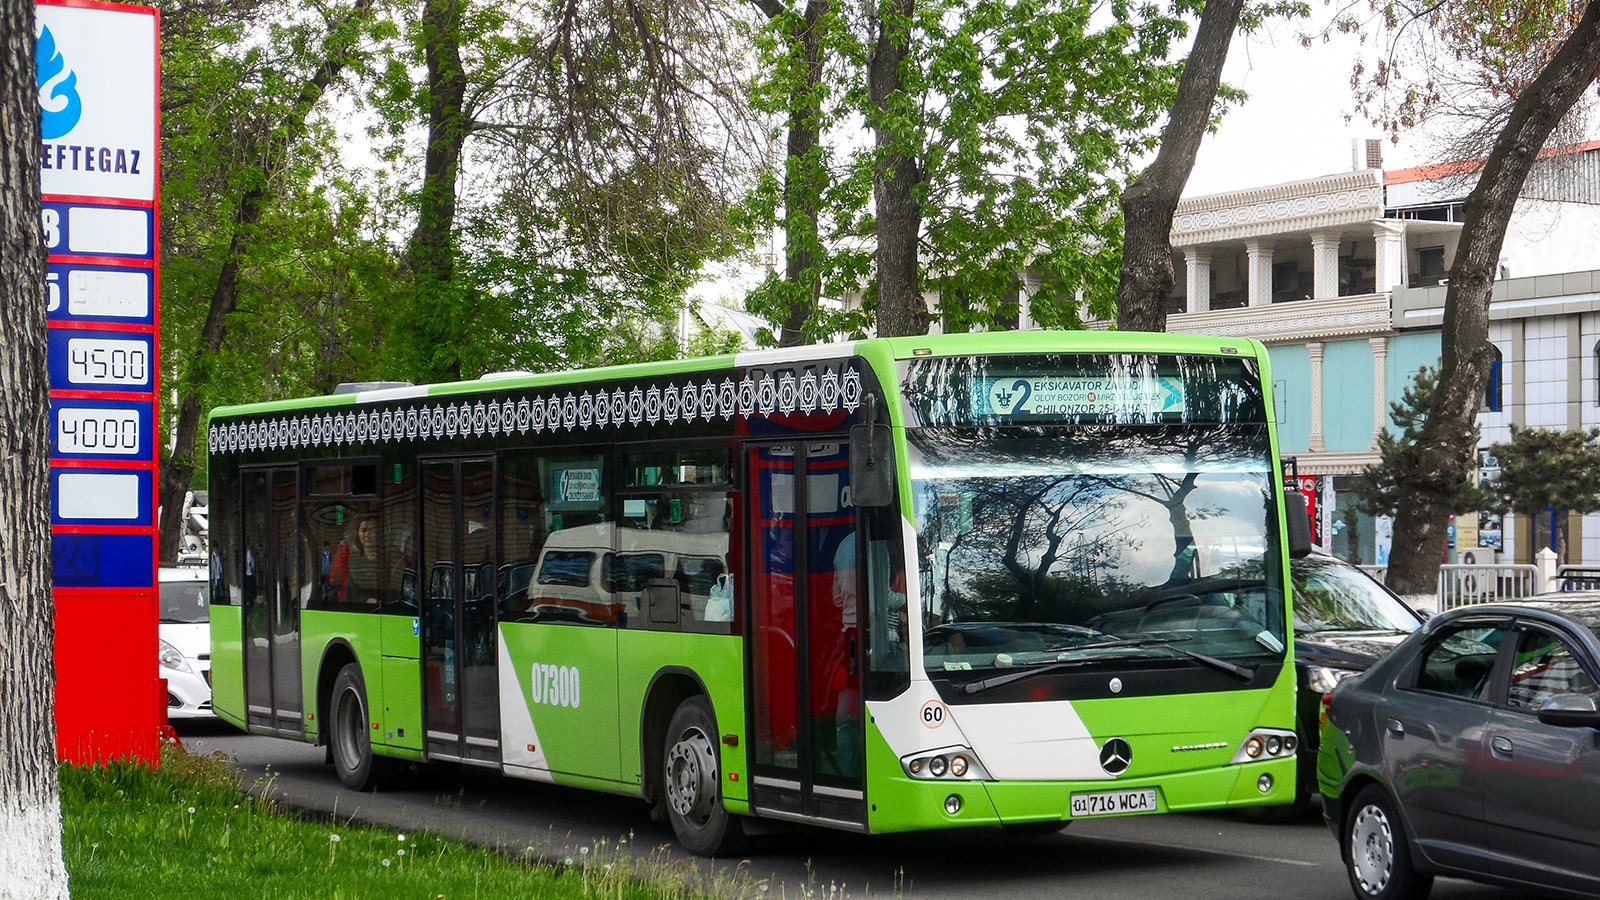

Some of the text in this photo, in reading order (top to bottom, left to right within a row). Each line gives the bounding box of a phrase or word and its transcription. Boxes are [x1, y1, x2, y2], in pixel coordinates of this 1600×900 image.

[72, 347, 145, 380] 4500
[1034, 381, 1102, 392] EKSKAVATOR
[1010, 379, 1032, 414] 2
[1034, 393, 1057, 402] OLOY
[1057, 393, 1087, 402] BOZORI
[1036, 404, 1096, 414] CHILONZOR
[62, 418, 137, 449] 4000
[531, 662, 581, 709] 07300
[923, 706, 943, 722] 60
[1074, 793, 1147, 812] 01 716 WCA
